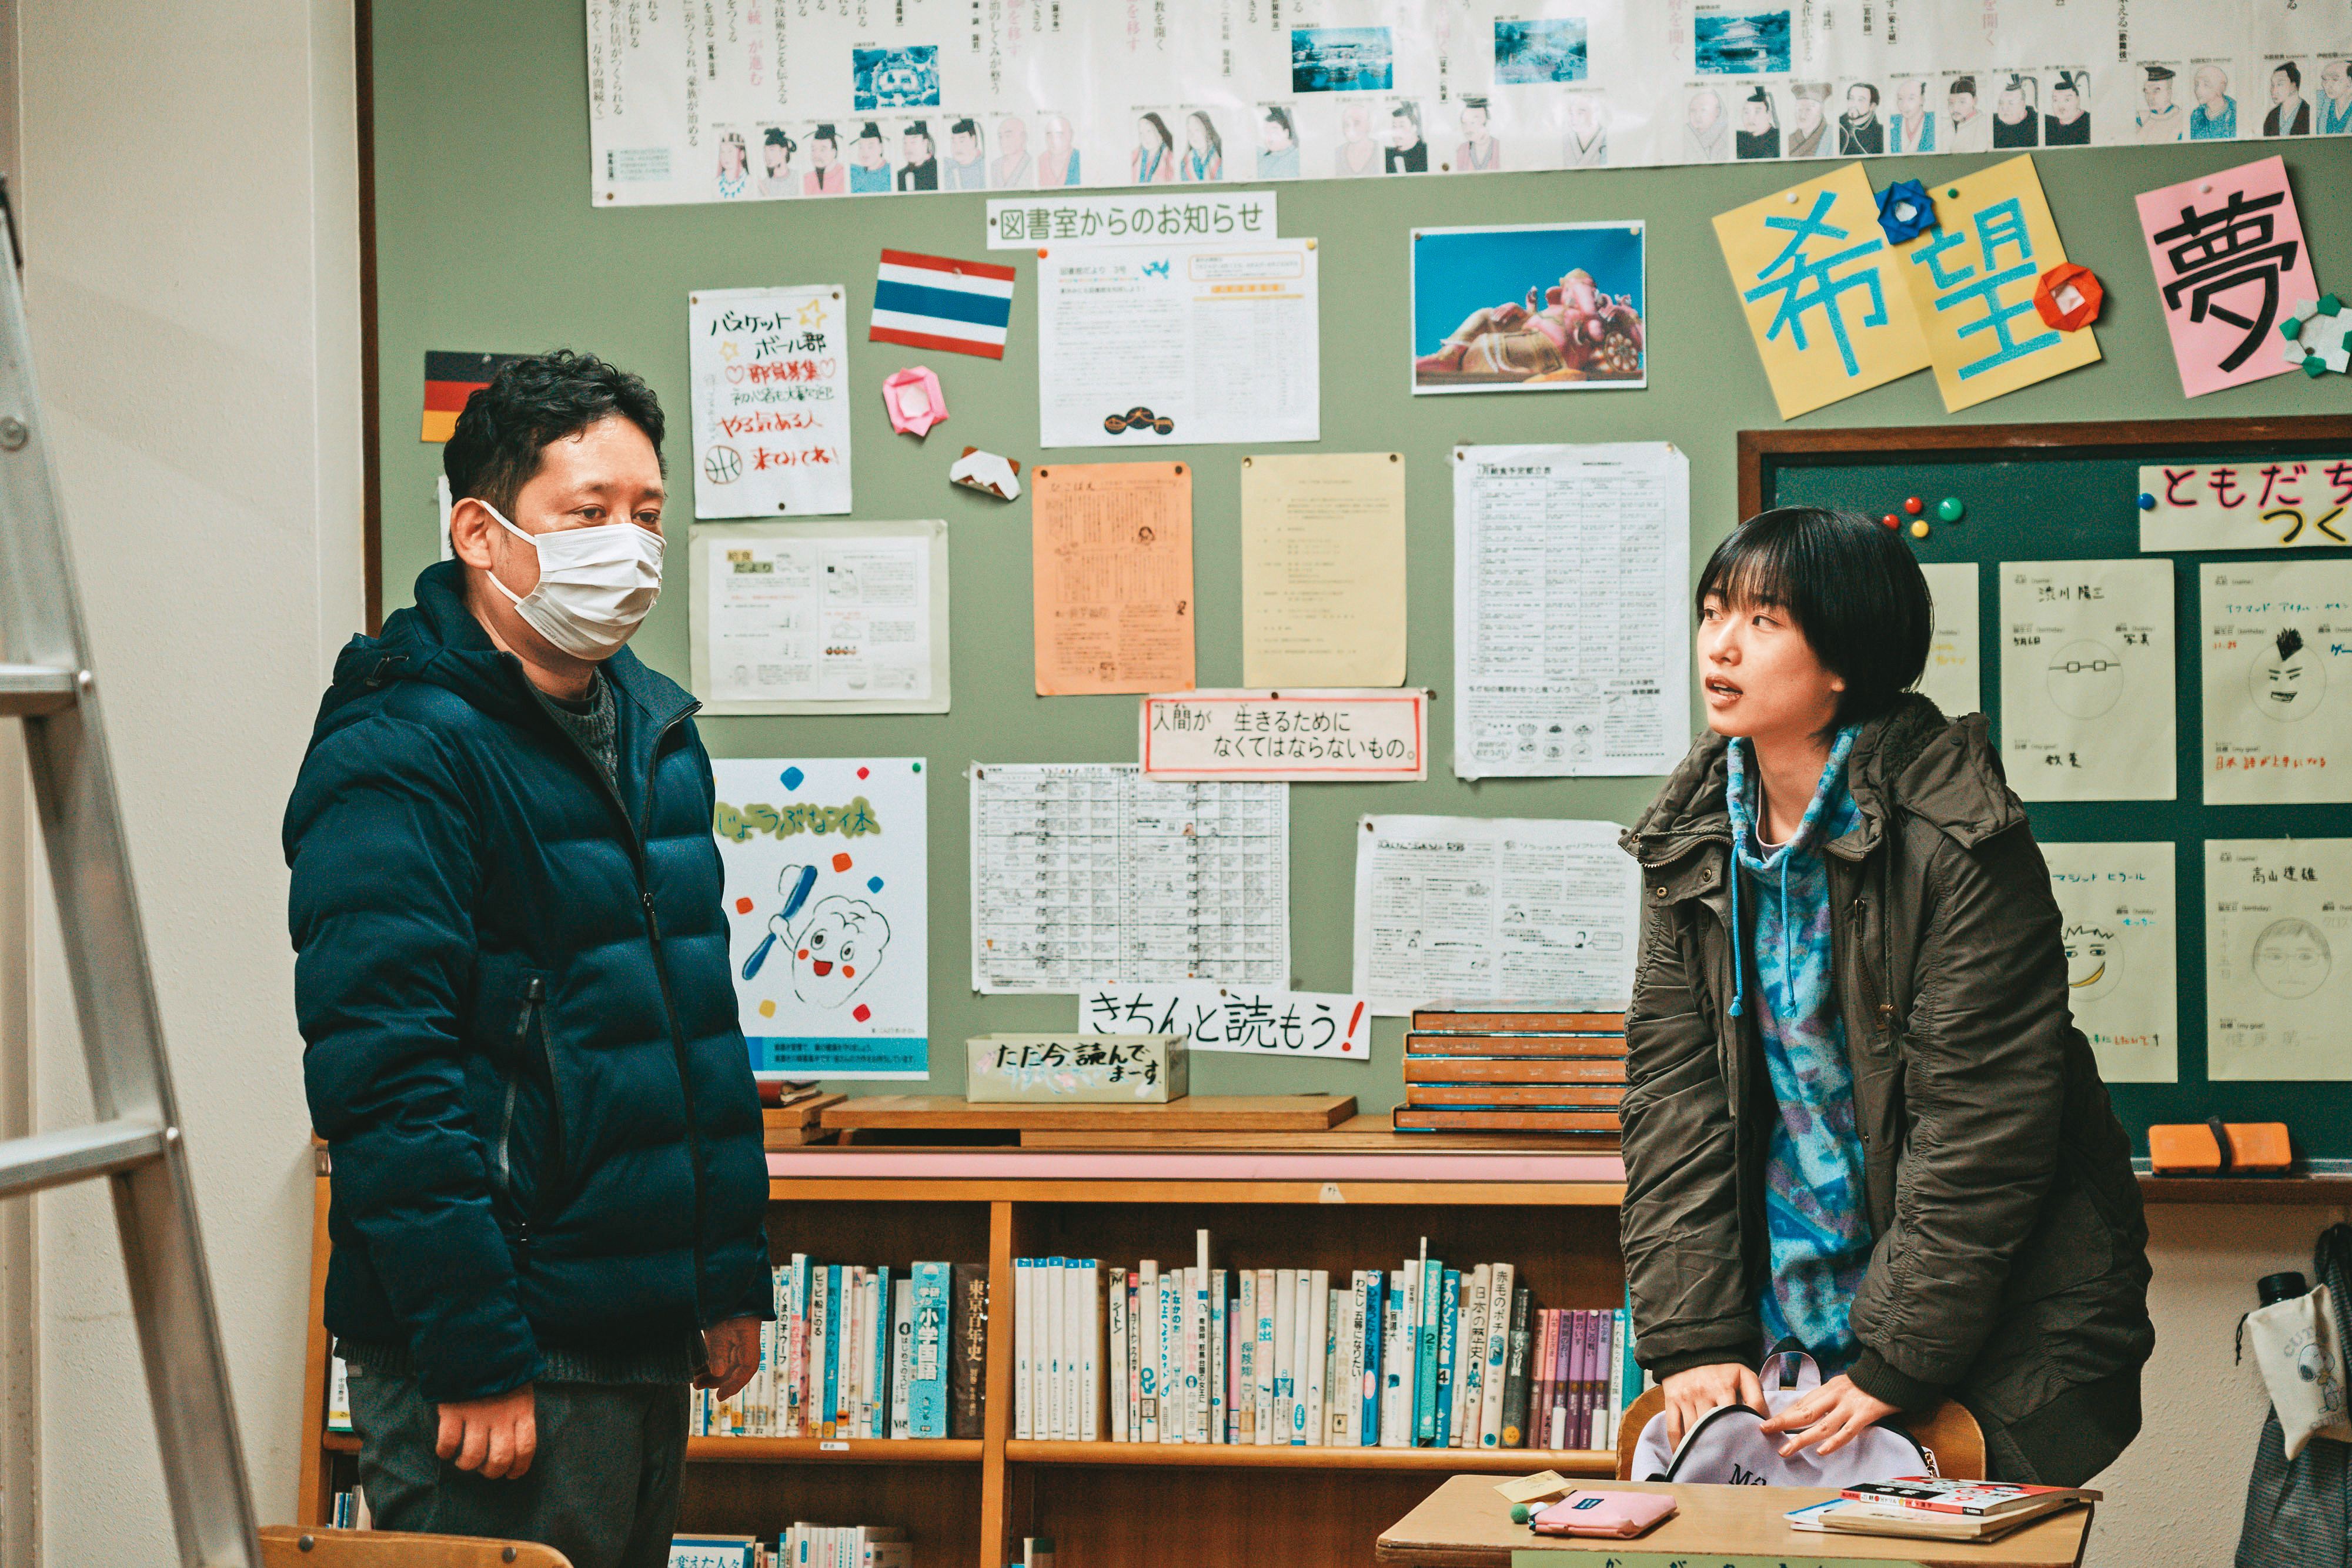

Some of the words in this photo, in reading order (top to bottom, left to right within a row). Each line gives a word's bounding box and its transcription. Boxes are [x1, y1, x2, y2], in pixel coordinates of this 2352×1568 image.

[1001, 202, 1264, 240] 図書室からのお知らせ
[2154, 189, 2298, 373] 夢
[711, 310, 791, 336] バスケット
[756, 332, 827, 359] ボール部
[716, 410, 823, 439] やる気ある人
[2163, 462, 2352, 510] ともだち
[1154, 707, 1211, 731] 人間が
[1235, 708, 1351, 733] 生きるために
[1214, 735, 1416, 760] なくてはならないもの。
[967, 1279, 985, 1362] 東京百年史
[1493, 1270, 1506, 1333] 赤毛のポチ
[1470, 1286, 1486, 1359] 日本の歴史
